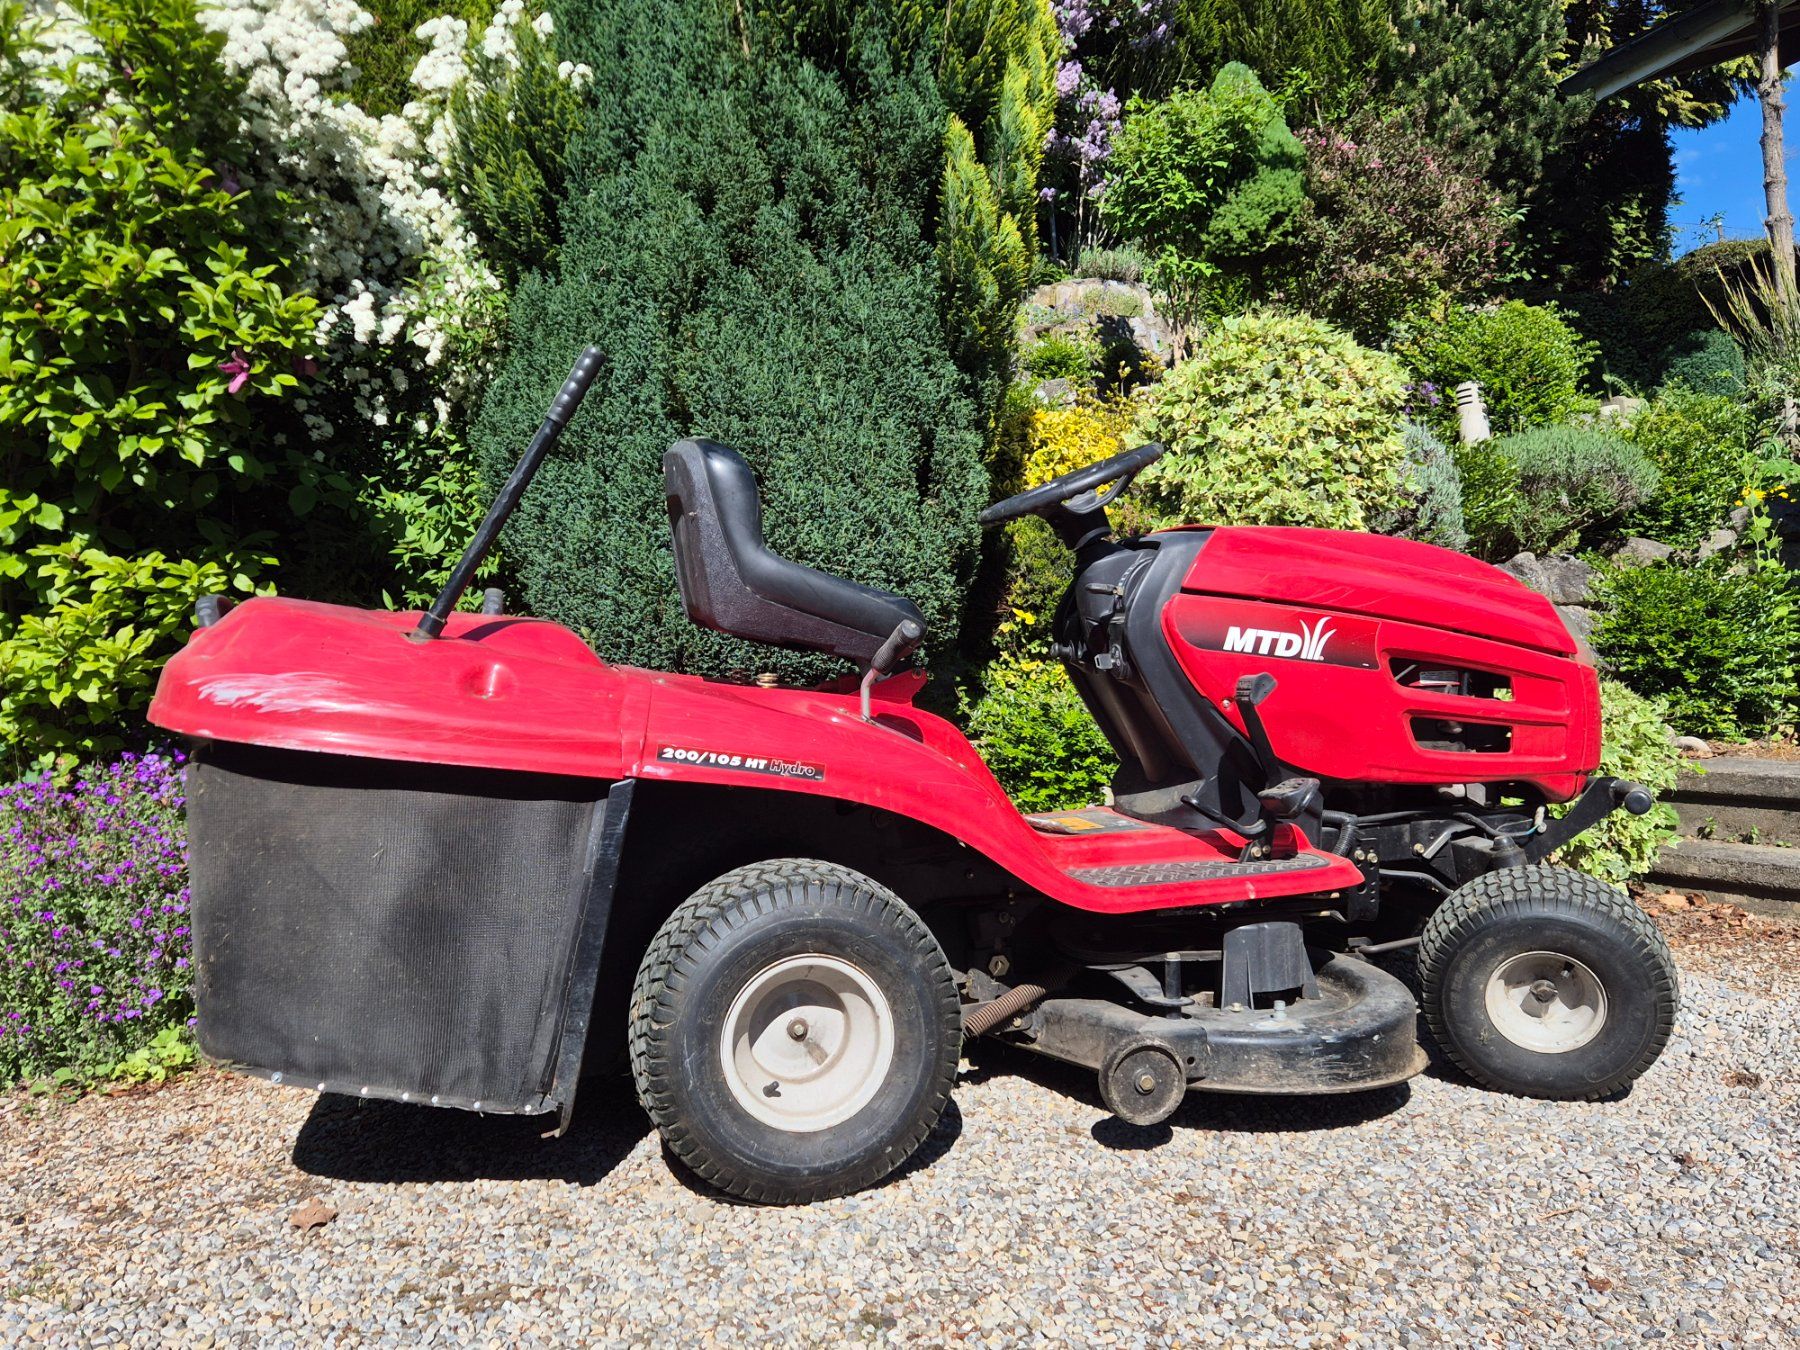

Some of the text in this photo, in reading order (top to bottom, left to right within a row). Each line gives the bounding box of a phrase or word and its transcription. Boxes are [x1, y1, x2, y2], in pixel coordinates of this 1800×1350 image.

[1223, 626, 1302, 657] MTD
[662, 748, 815, 776] 200/105 HT Hydro
